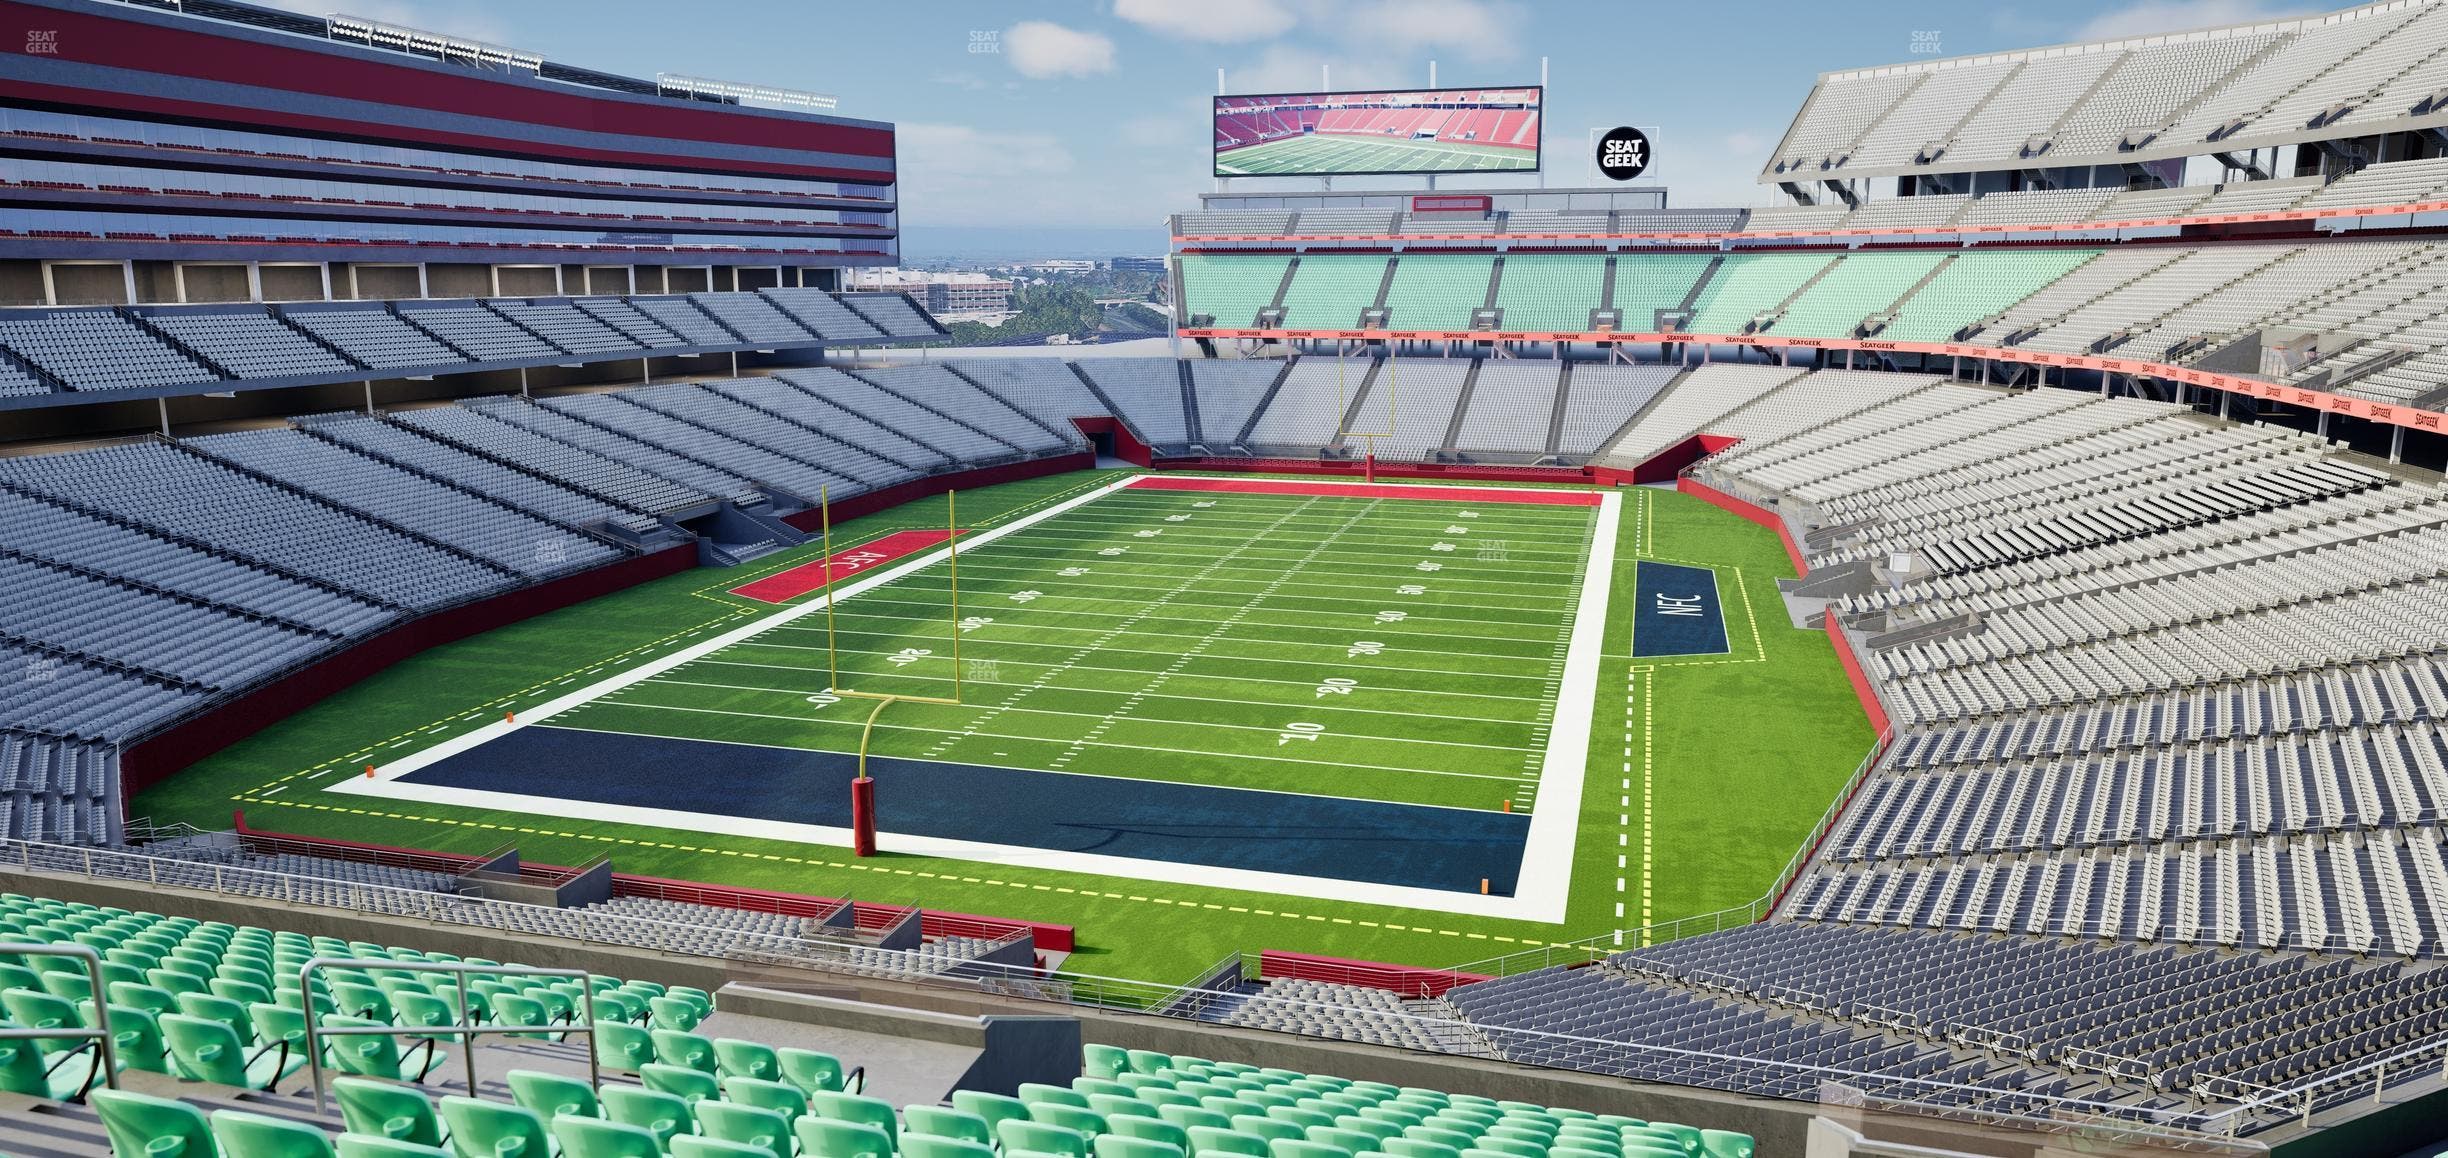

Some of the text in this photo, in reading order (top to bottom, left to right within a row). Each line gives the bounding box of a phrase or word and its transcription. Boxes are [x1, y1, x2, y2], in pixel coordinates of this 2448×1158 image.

[1605, 139, 1643, 154] SEAT
[1602, 153, 1643, 168] GEEK
[1725, 336, 1756, 344] SEATGEEK
[1788, 338, 1821, 347] SEATGEEK
[1860, 341, 1896, 351] SEATGEEK
[2370, 404, 2392, 420] SEATGEEK
[2415, 412, 2440, 430] SEATGEEK
[819, 551, 888, 570] AFC
[1656, 592, 1703, 617] NFC
[1316, 677, 1358, 695] 20
[1280, 722, 1325, 742] 10
